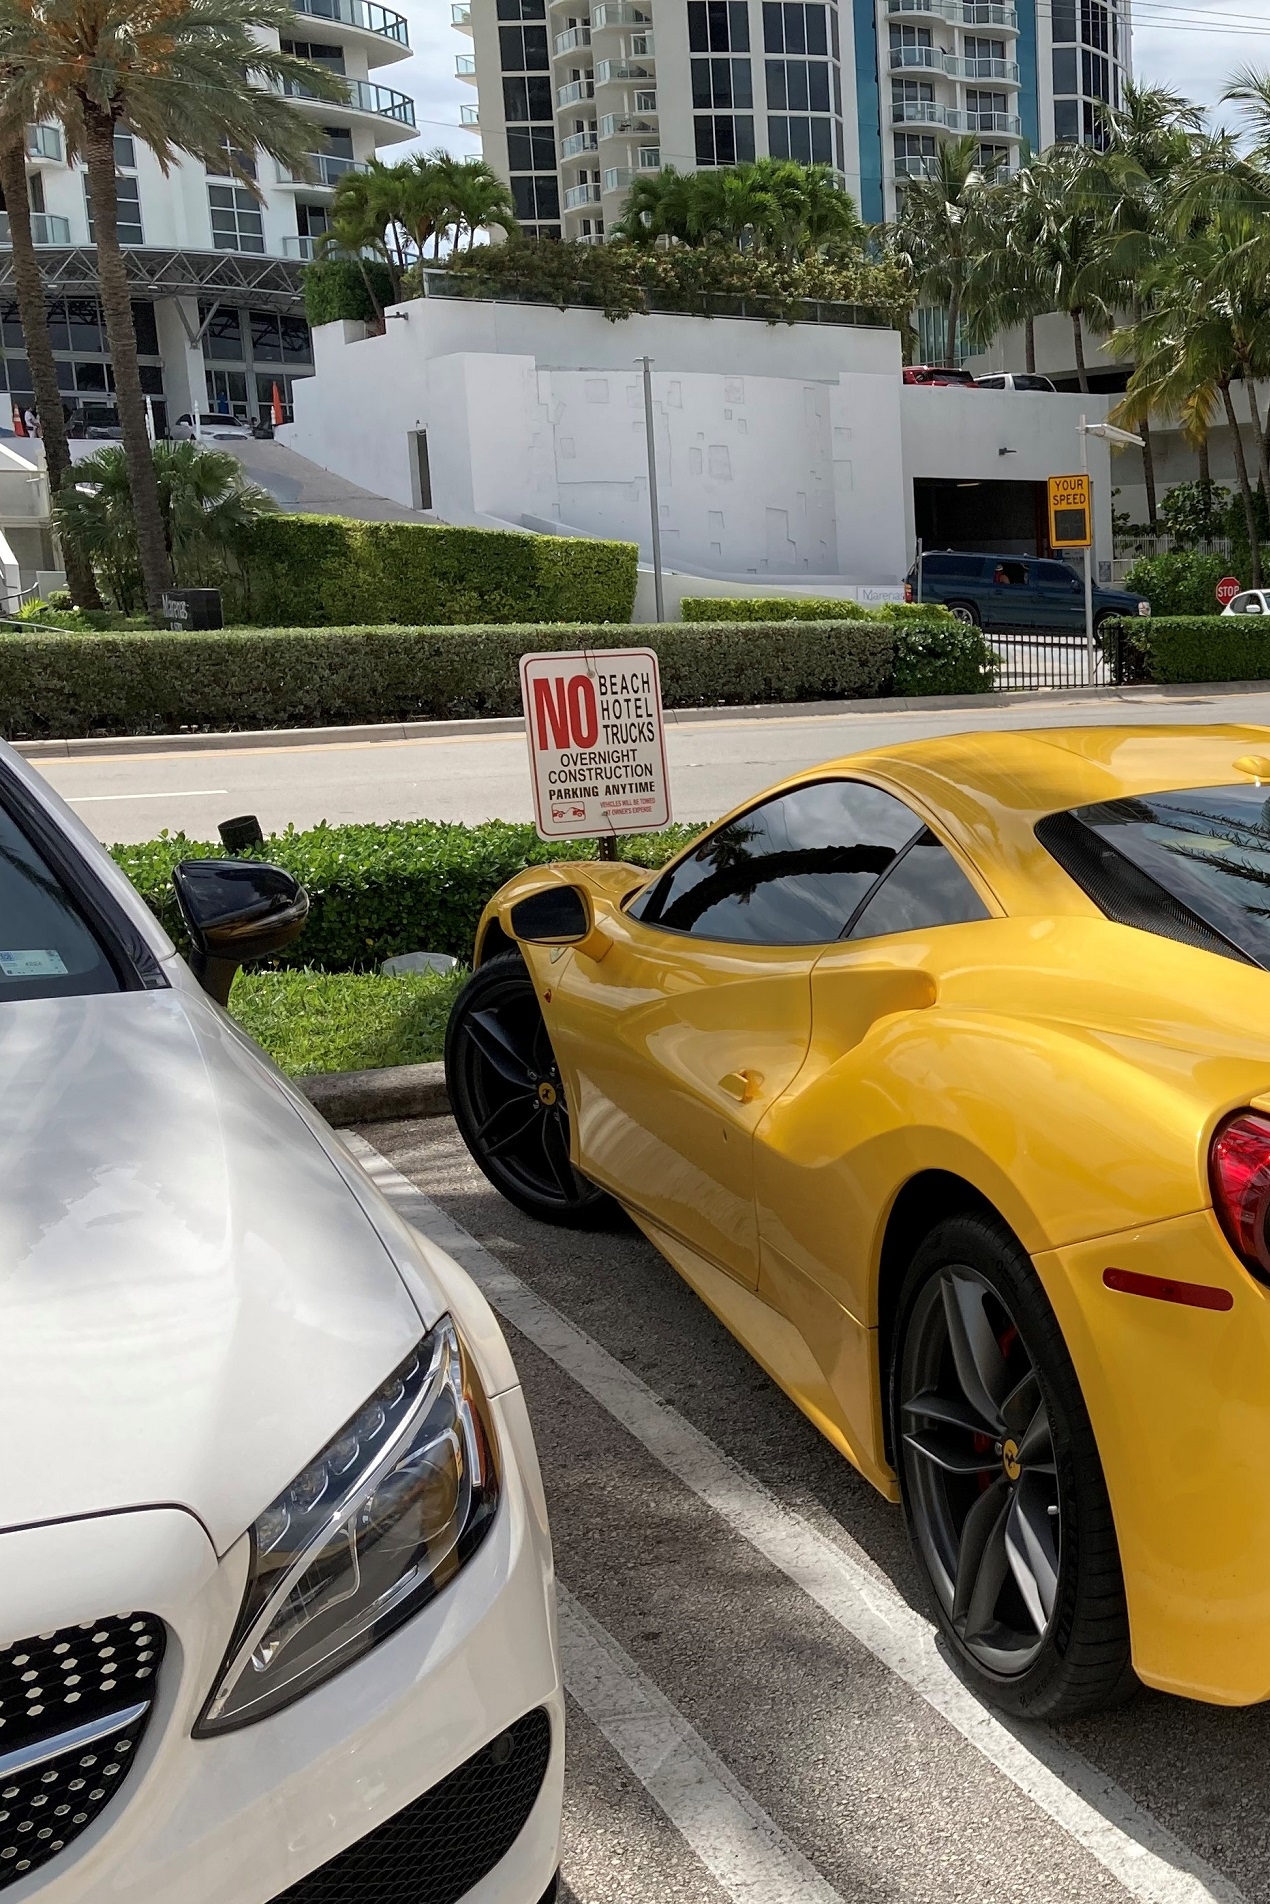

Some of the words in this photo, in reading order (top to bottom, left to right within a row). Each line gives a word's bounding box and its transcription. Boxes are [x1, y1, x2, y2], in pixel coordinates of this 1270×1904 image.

[1055, 479, 1084, 491] YOUR
[1053, 493, 1086, 505] SPEED
[863, 589, 904, 601] Marenas
[1218, 585, 1240, 597] STOP
[600, 672, 651, 696] BEACH
[533, 675, 599, 751] NO
[601, 698, 653, 721] HOTEL
[603, 721, 655, 745] TRUCKS
[560, 749, 638, 767] OVERNIGHT
[548, 763, 653, 784] CONSTRUCTION
[549, 785, 599, 800] PARKING
[605, 781, 656, 796] ANYTIME
